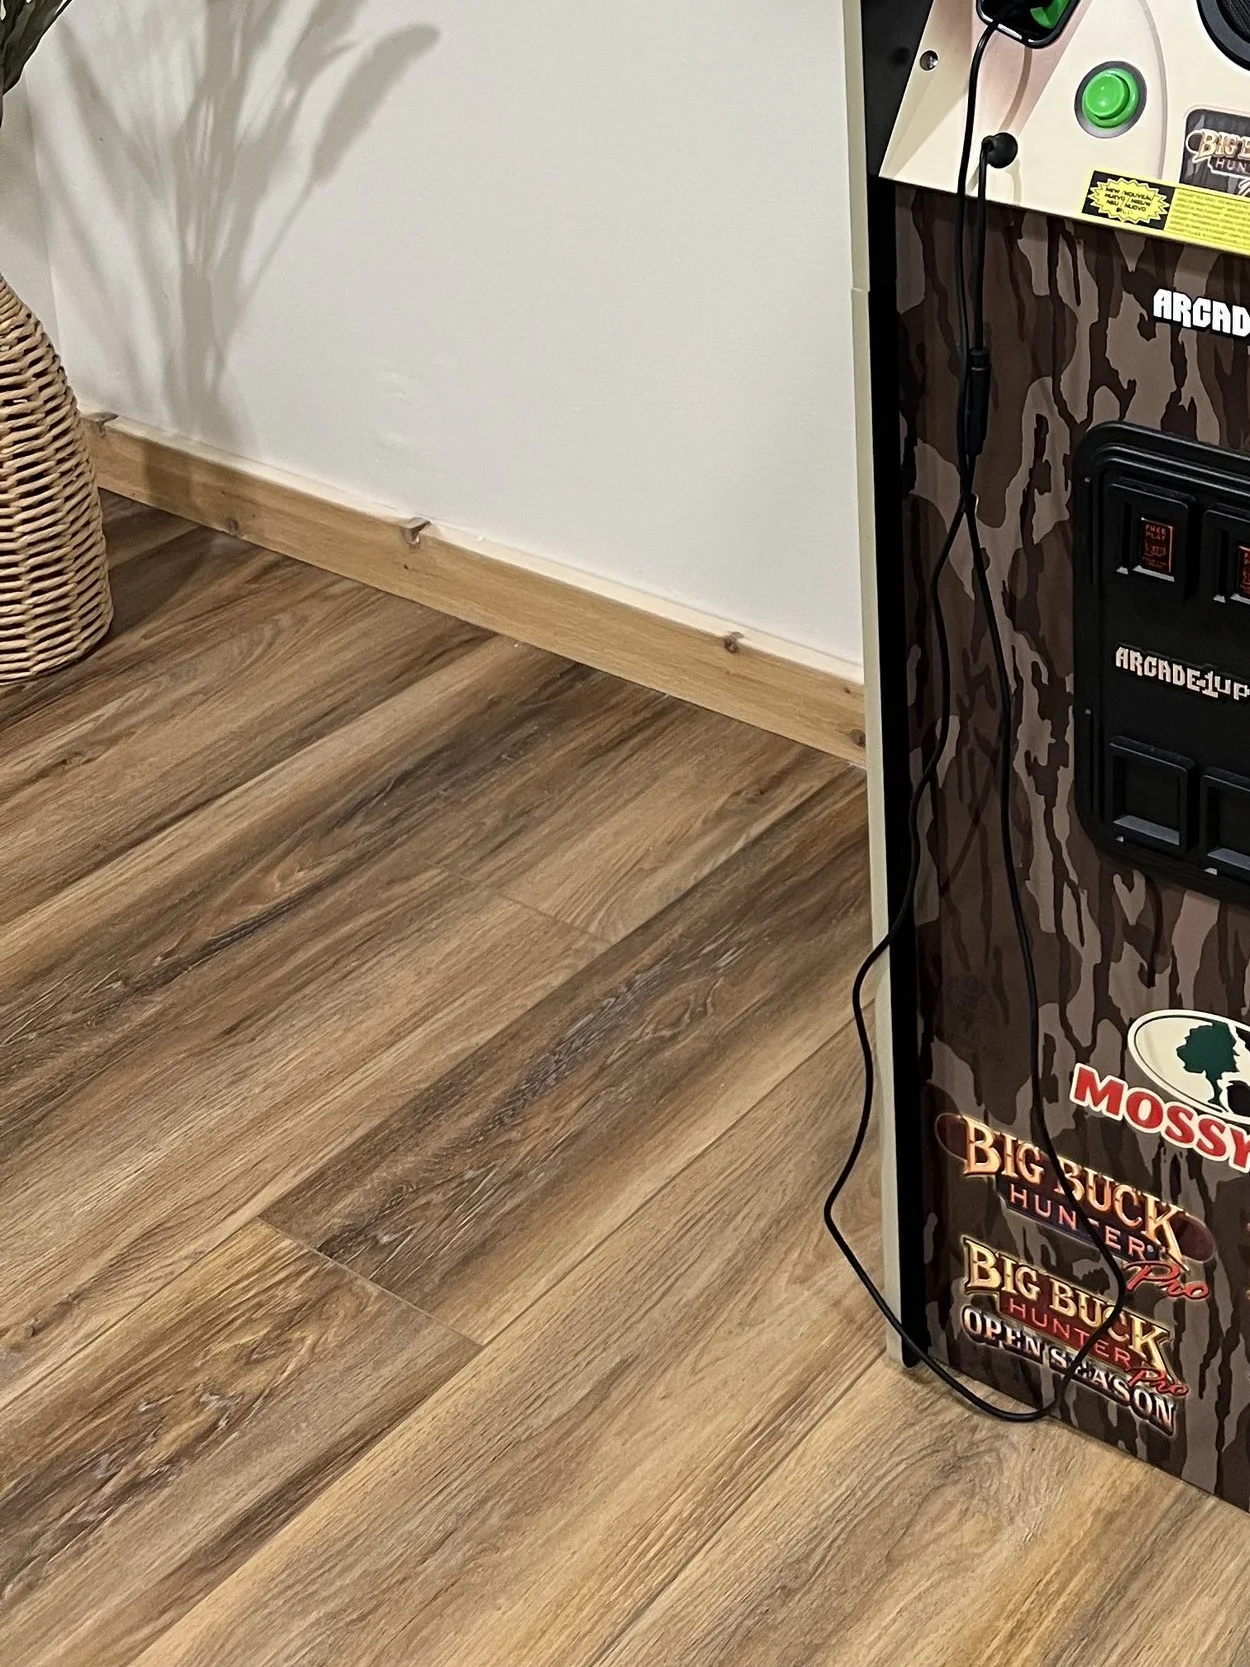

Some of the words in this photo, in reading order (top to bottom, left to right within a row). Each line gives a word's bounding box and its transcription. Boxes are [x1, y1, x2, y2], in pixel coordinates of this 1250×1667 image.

[1193, 131, 1238, 163] BIG
[963, 1115, 1046, 1185] BIG
[1056, 1156, 1191, 1272] BUCK
[963, 1236, 1043, 1302] BIG
[1049, 1275, 1174, 1383] BUCK
[1124, 1261, 1210, 1301] Pro
[962, 1307, 1043, 1365] OPEN
[1008, 1298, 1133, 1370] HUNTER
[1127, 1365, 1190, 1397] Pro
